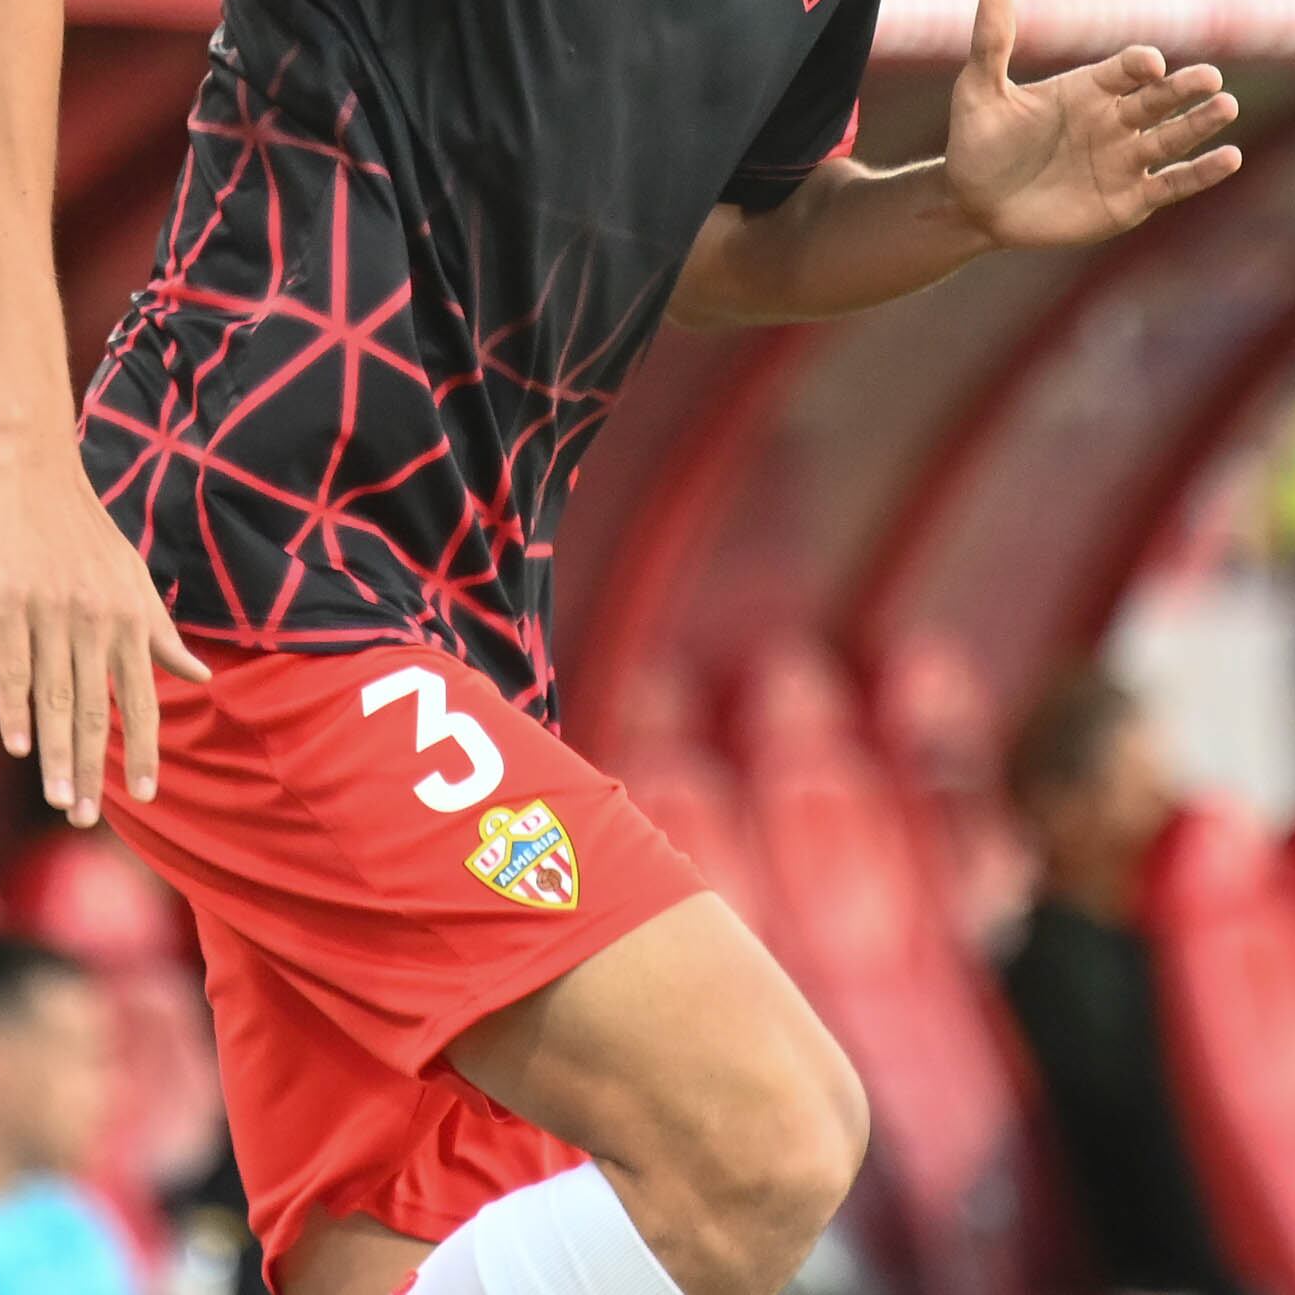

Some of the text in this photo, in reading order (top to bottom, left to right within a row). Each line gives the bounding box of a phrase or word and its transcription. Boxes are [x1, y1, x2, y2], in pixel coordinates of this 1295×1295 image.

[361, 665, 505, 814] 3
[479, 814, 542, 869] U D
